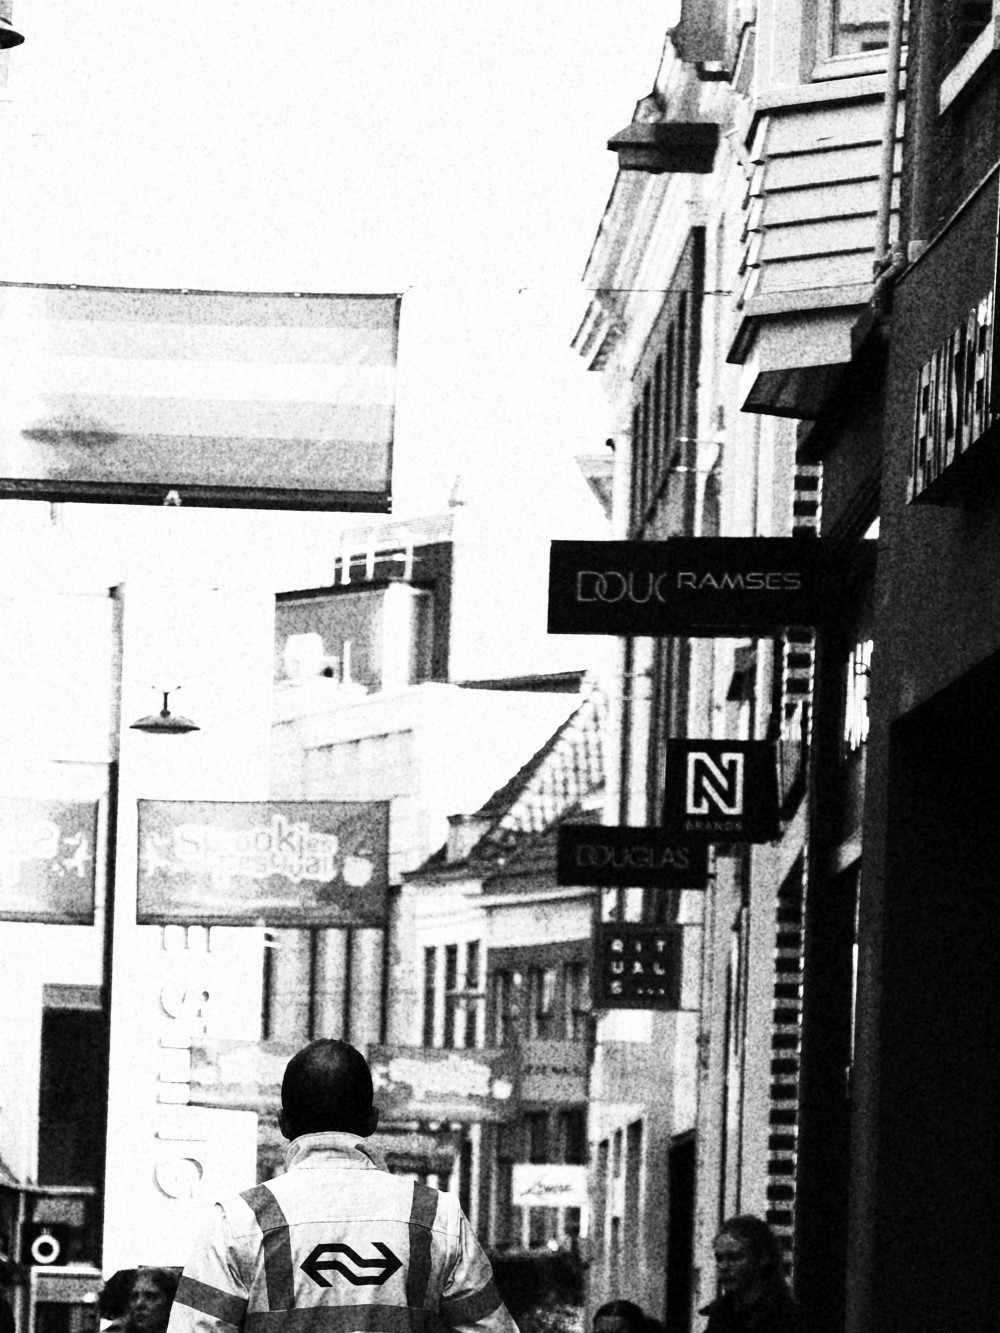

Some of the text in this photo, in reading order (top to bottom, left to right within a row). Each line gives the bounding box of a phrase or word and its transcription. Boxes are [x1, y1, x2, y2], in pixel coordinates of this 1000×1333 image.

[906, 327, 961, 504] JEANS
[677, 572, 802, 590] RAMSES
[575, 844, 690, 869] DOUGLAS
